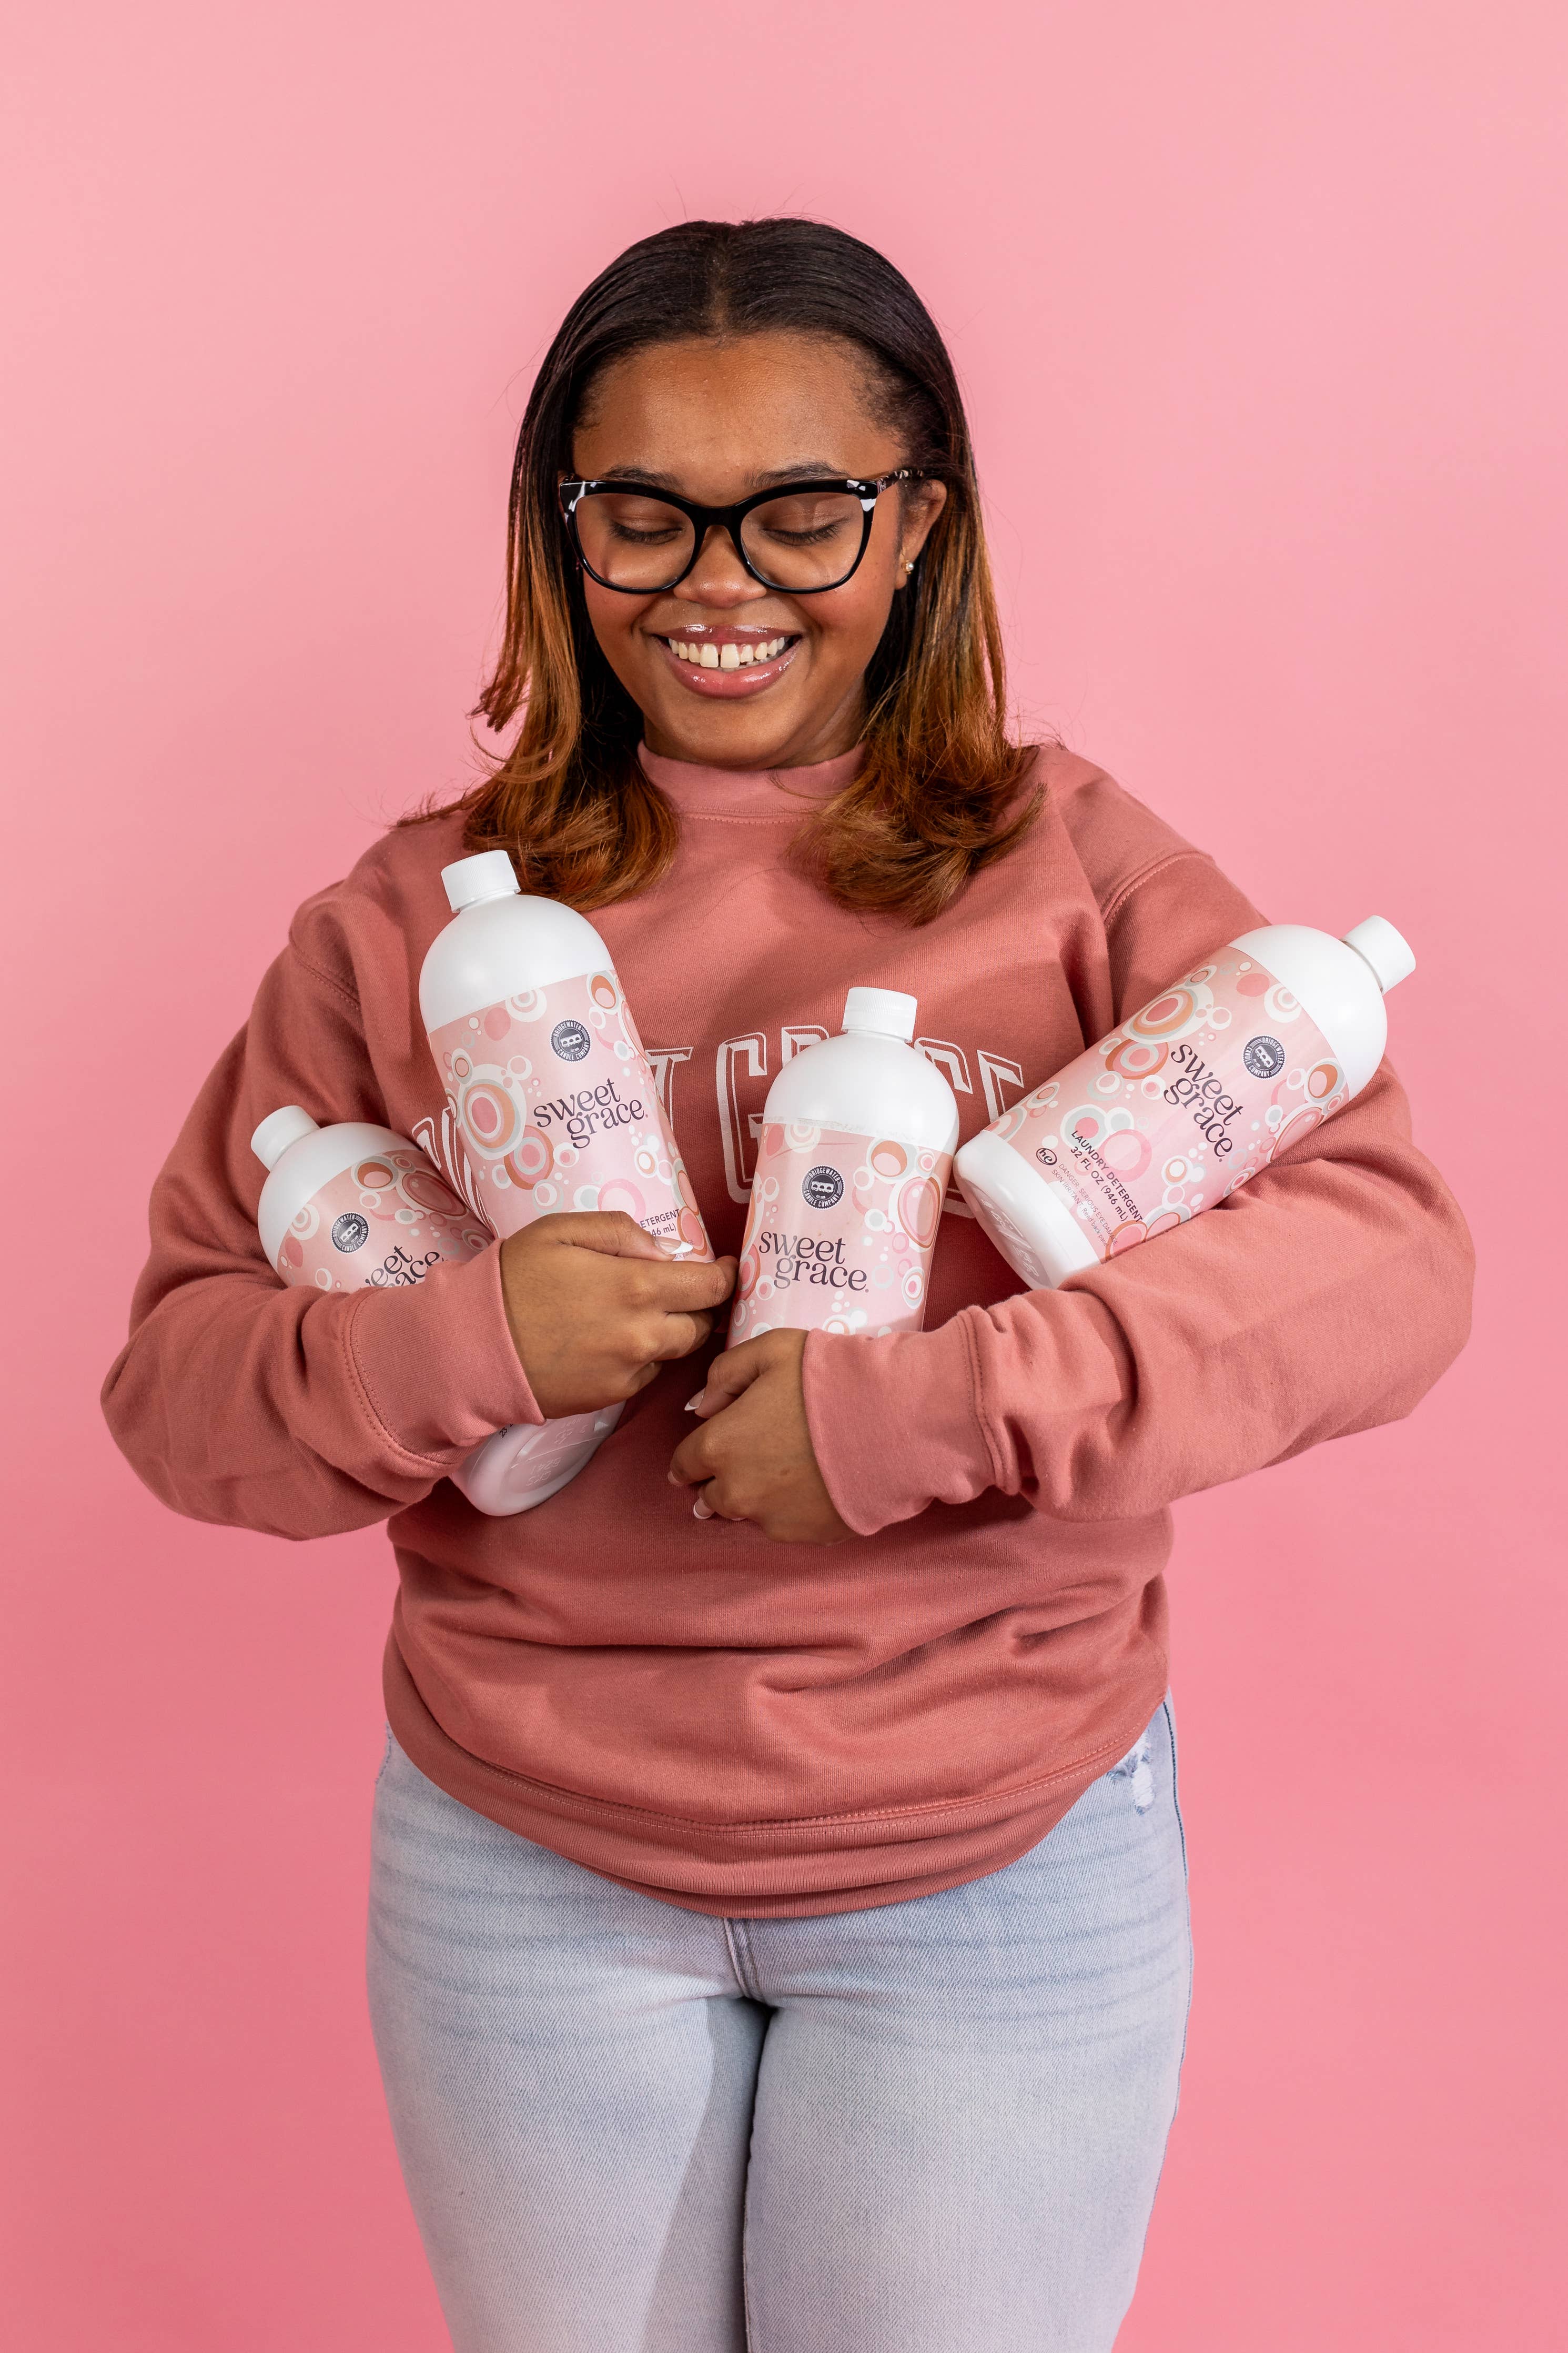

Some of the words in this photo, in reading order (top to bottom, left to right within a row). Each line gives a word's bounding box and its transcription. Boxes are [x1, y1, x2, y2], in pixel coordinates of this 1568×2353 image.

[553, 1021, 582, 1037] BRIDGEWATER
[575, 1041, 589, 1059] COMPANY
[1262, 1037, 1283, 1063] BRIDGEWATER
[1171, 1044, 1243, 1125] sweet
[1249, 1065, 1269, 1077] COMPANY
[533, 1078, 620, 1127] sweet
[809, 1168, 841, 1181] BRIDGEWATER
[1070, 1147, 1083, 1158] 32
[1080, 1158, 1091, 1170] FL
[1091, 1171, 1104, 1185] OZ
[1100, 1185, 1118, 1204] (946
[1115, 1205, 1128, 1222] mL)
[1071, 1130, 1109, 1171] LAUNDRY
[1106, 1172, 1142, 1222] DETERGENT
[818, 1194, 839, 1207] COMPANY
[1052, 1169, 1064, 1183] SKIN
[1082, 1208, 1094, 1222] Read
[1091, 1221, 1101, 1234] back
[1079, 1188, 1098, 1212] SERIOUS
[1096, 1212, 1105, 1223] EYE
[332, 1214, 355, 1237] BRIDGEWATER
[640, 1209, 680, 1228] ETERGENT
[663, 1223, 676, 1233] mL)
[759, 1232, 846, 1264] sweet
[365, 1245, 413, 1288] eet
[388, 1252, 444, 1287] ace
